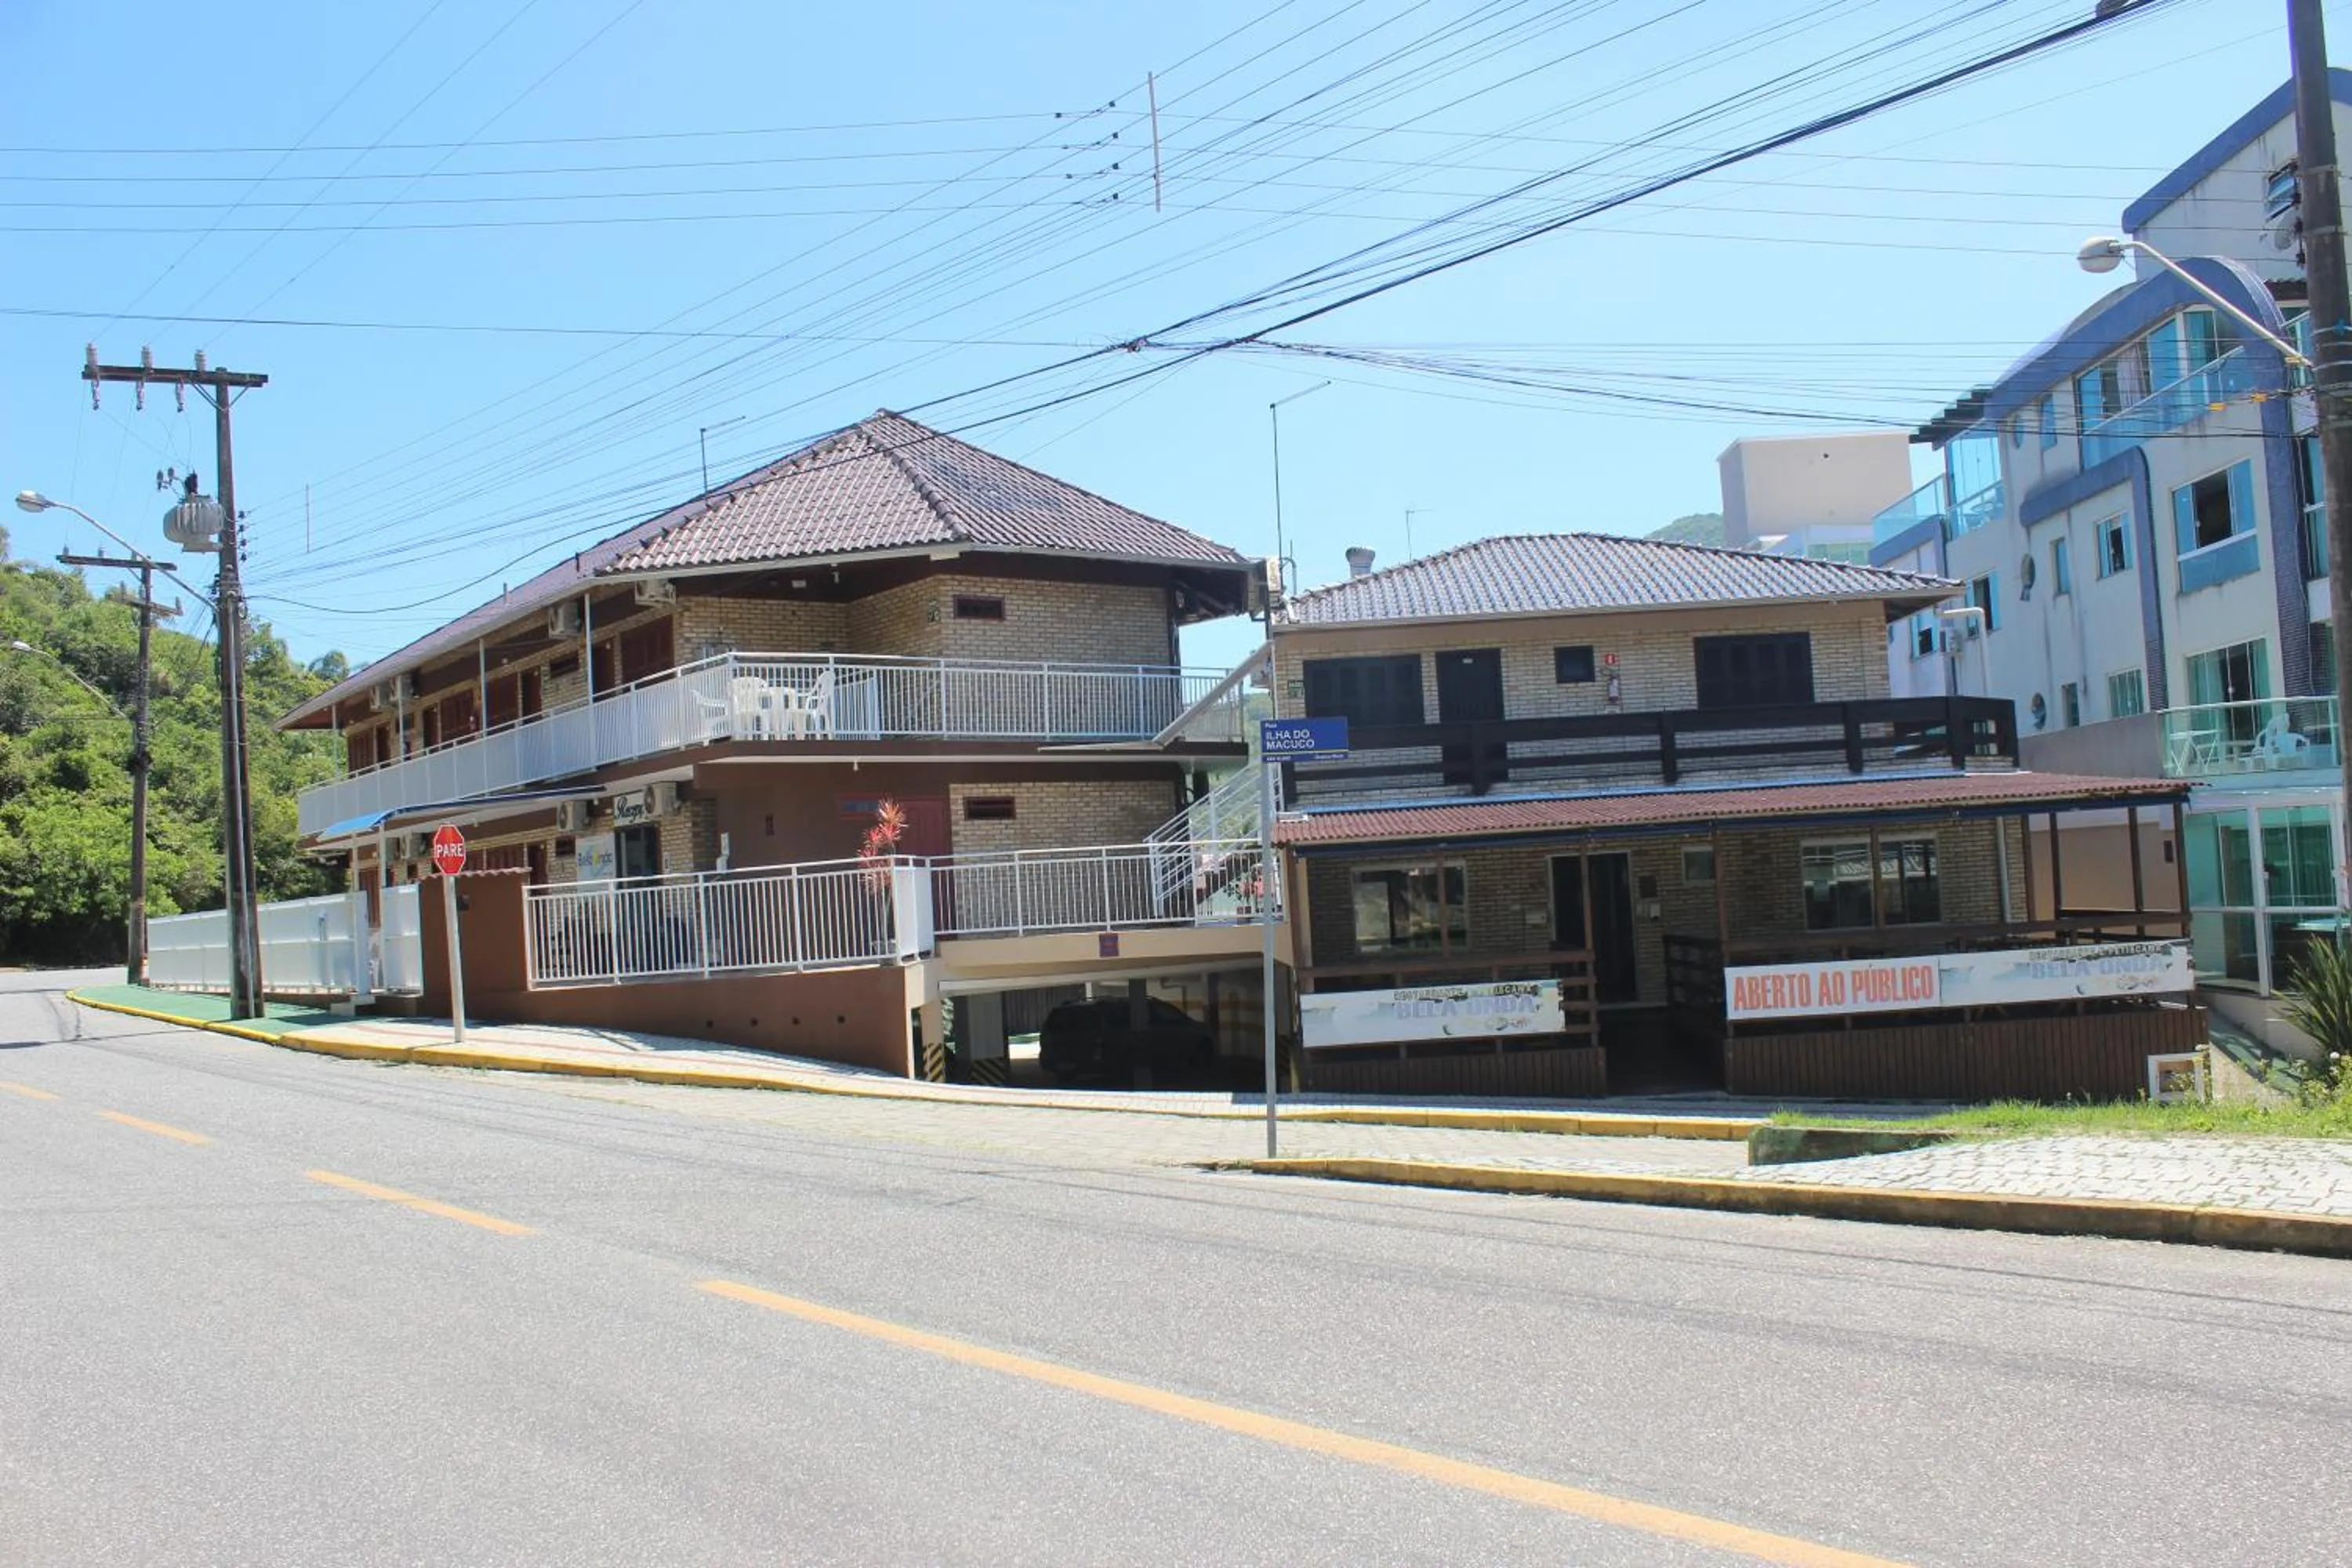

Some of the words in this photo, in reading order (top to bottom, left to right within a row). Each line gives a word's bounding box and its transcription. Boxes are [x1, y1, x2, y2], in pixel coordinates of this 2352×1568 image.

[1265, 729, 1291, 740] ILHA
[1293, 728, 1310, 739] DO
[1265, 739, 1315, 750] MACUCO
[436, 843, 463, 858] PARE
[1733, 972, 1812, 1011] ABERTO
[1818, 971, 1846, 1007] AO
